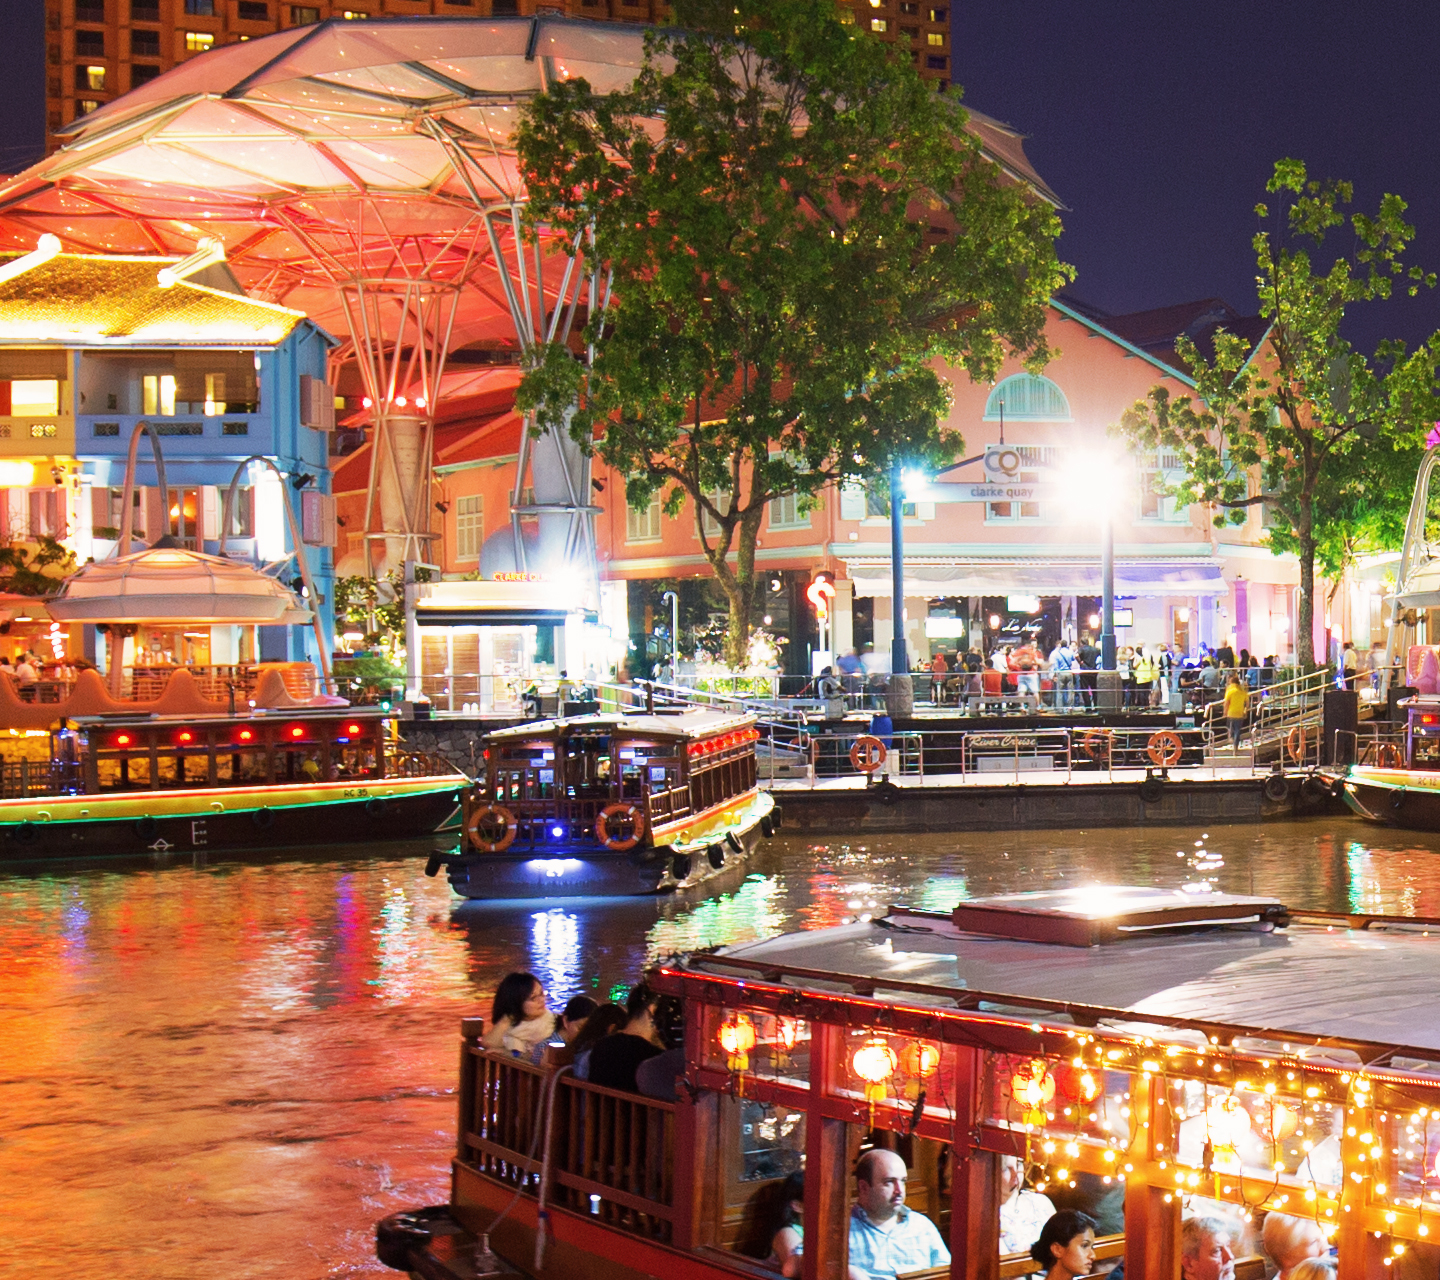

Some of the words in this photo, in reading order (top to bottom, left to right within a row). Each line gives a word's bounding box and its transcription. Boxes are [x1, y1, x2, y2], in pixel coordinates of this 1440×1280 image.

[985, 450, 1020, 477] CQ
[970, 486, 1003, 497] clarke
[1006, 487, 1034, 499] quay
[969, 735, 1000, 747] River
[1001, 735, 1036, 747] Cruise
[343, 789, 355, 798] RC
